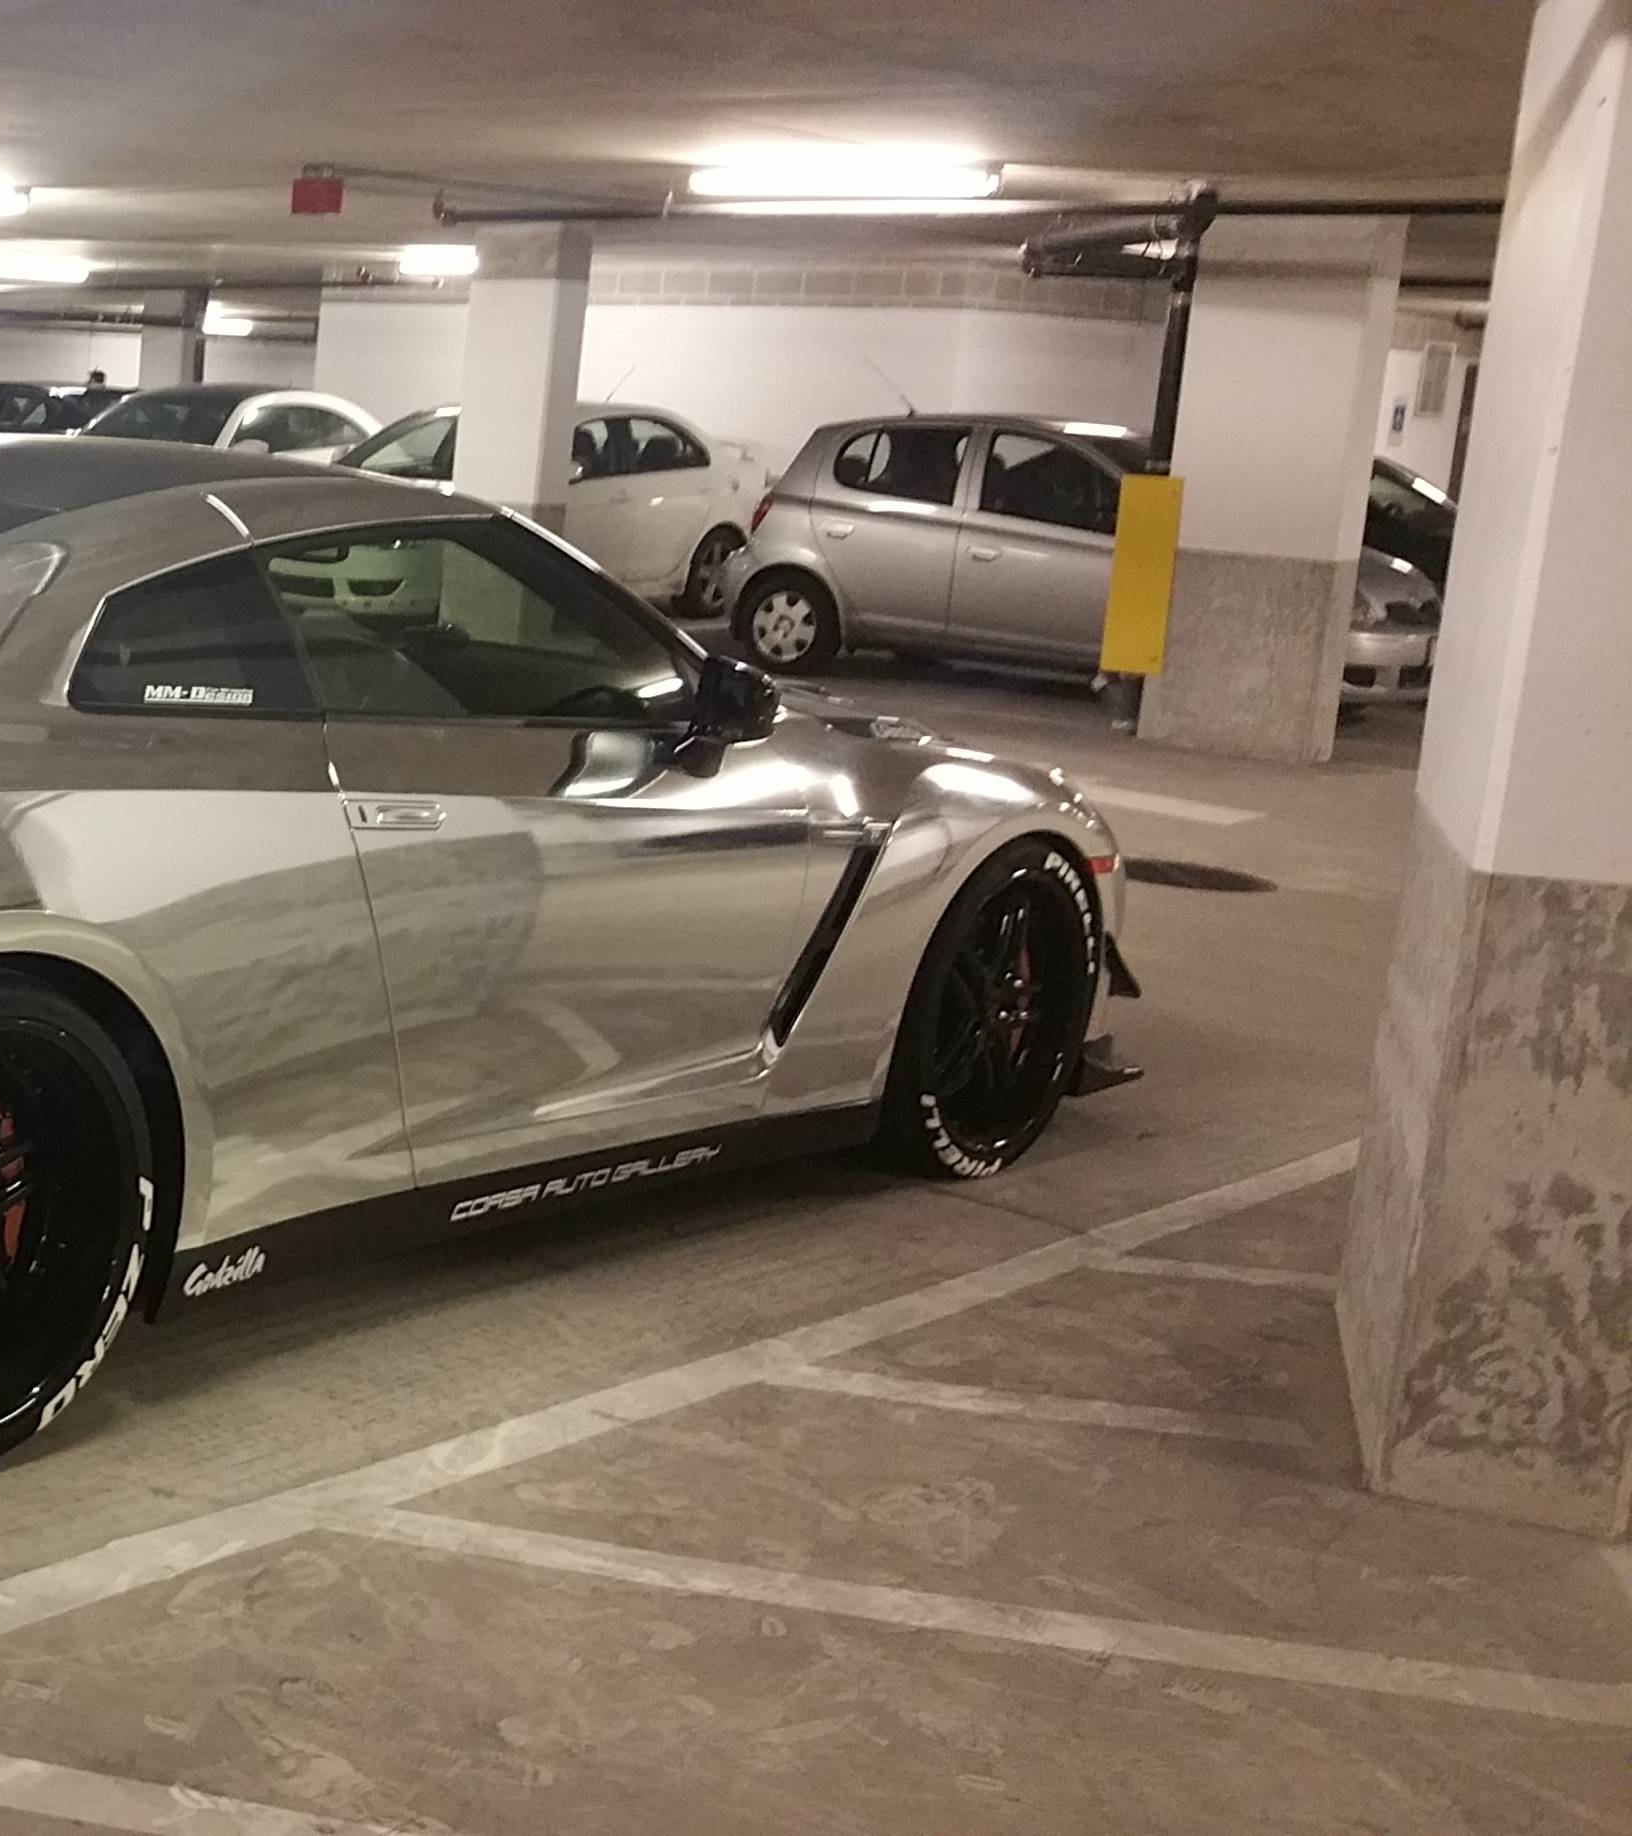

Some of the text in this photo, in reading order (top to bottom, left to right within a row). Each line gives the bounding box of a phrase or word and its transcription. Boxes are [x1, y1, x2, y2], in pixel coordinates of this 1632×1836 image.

[450, 1144, 722, 1222] CORSA AUTO GALLERY
